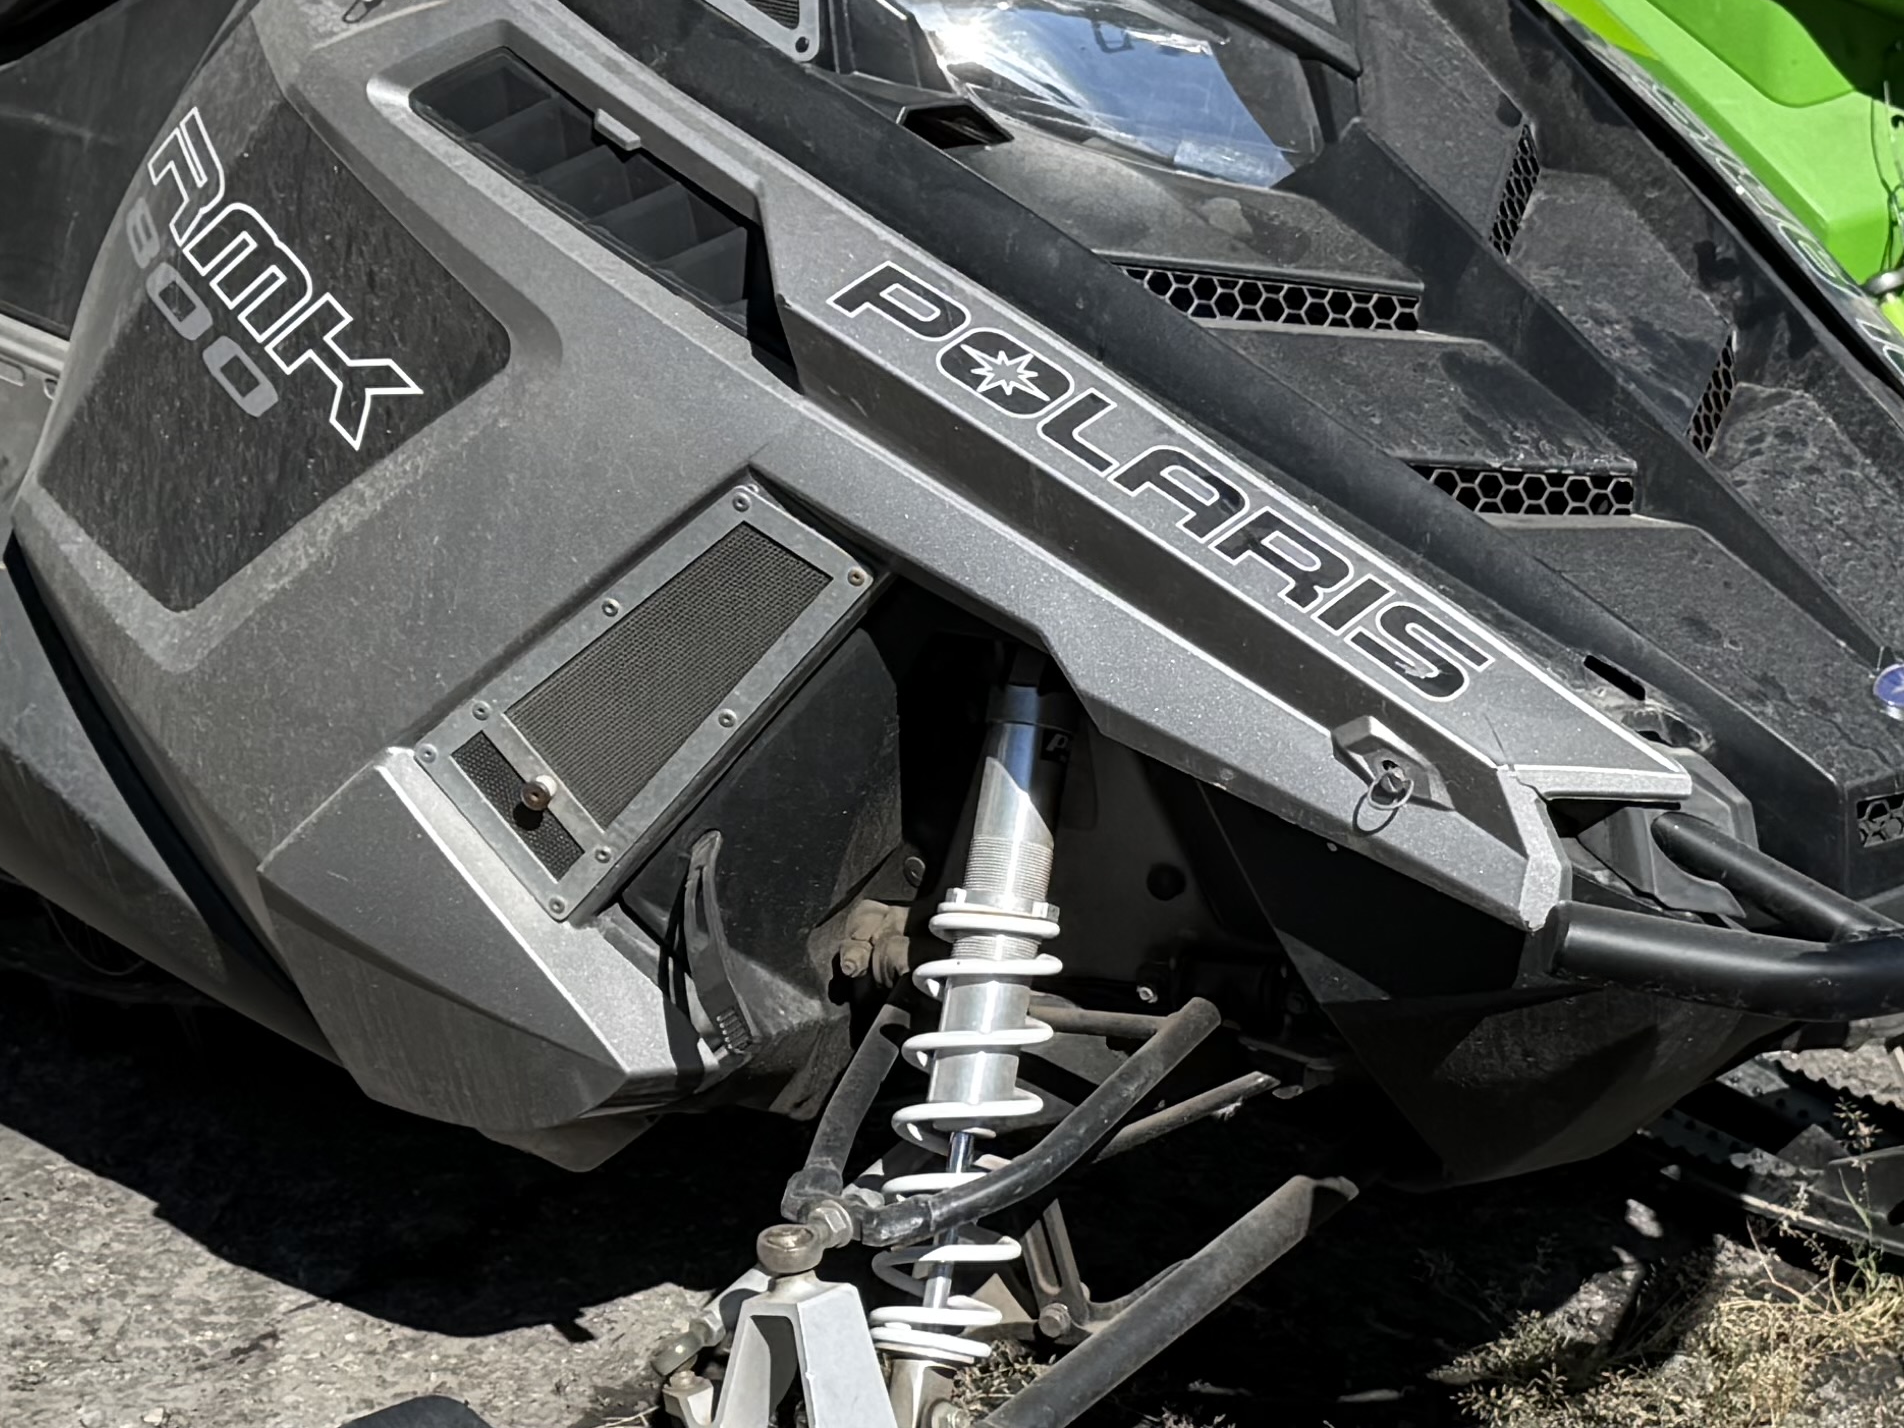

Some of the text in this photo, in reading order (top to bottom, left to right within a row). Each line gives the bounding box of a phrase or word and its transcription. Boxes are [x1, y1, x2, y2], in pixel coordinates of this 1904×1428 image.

[125, 196, 279, 419] 800
[147, 106, 425, 452] RMK
[825, 260, 1499, 703] POLARIS
